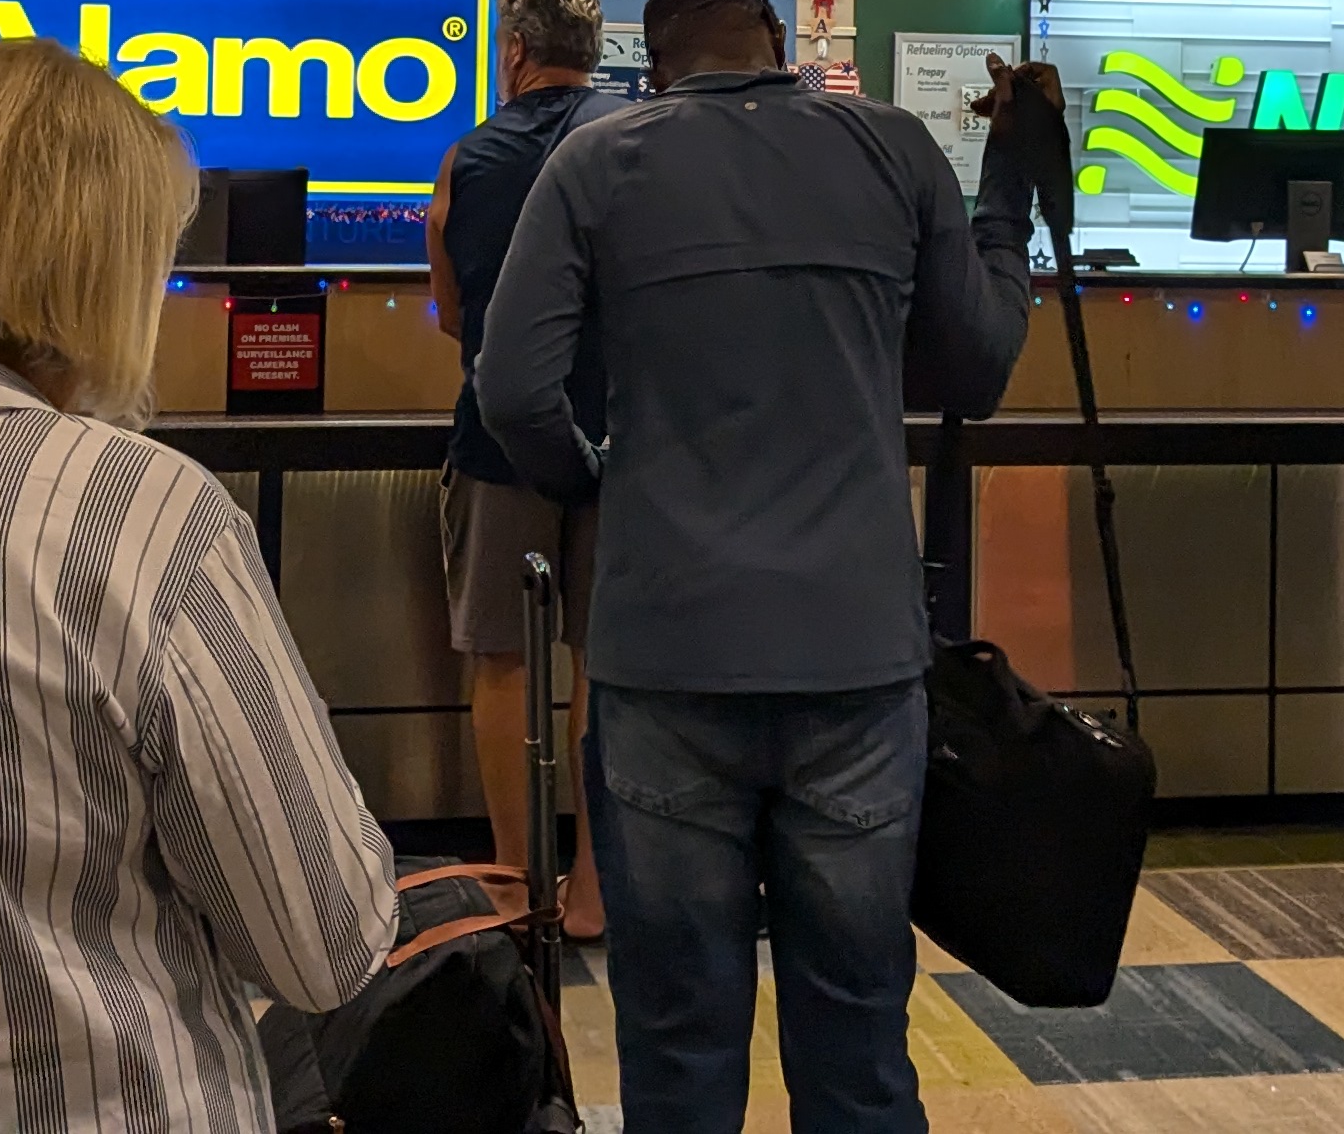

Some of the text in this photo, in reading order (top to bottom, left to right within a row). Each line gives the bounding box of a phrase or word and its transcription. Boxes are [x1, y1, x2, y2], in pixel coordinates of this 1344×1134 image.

[906, 43, 954, 58] Refueling
[906, 66, 946, 79] 1. Prepay
[254, 323, 300, 333] NO CASH
[241, 334, 312, 343] ON PREMISES.
[236, 350, 313, 359] SURVEILLANCE
[250, 360, 299, 369] CAMERAS
[251, 371, 301, 380] PRESENT.
